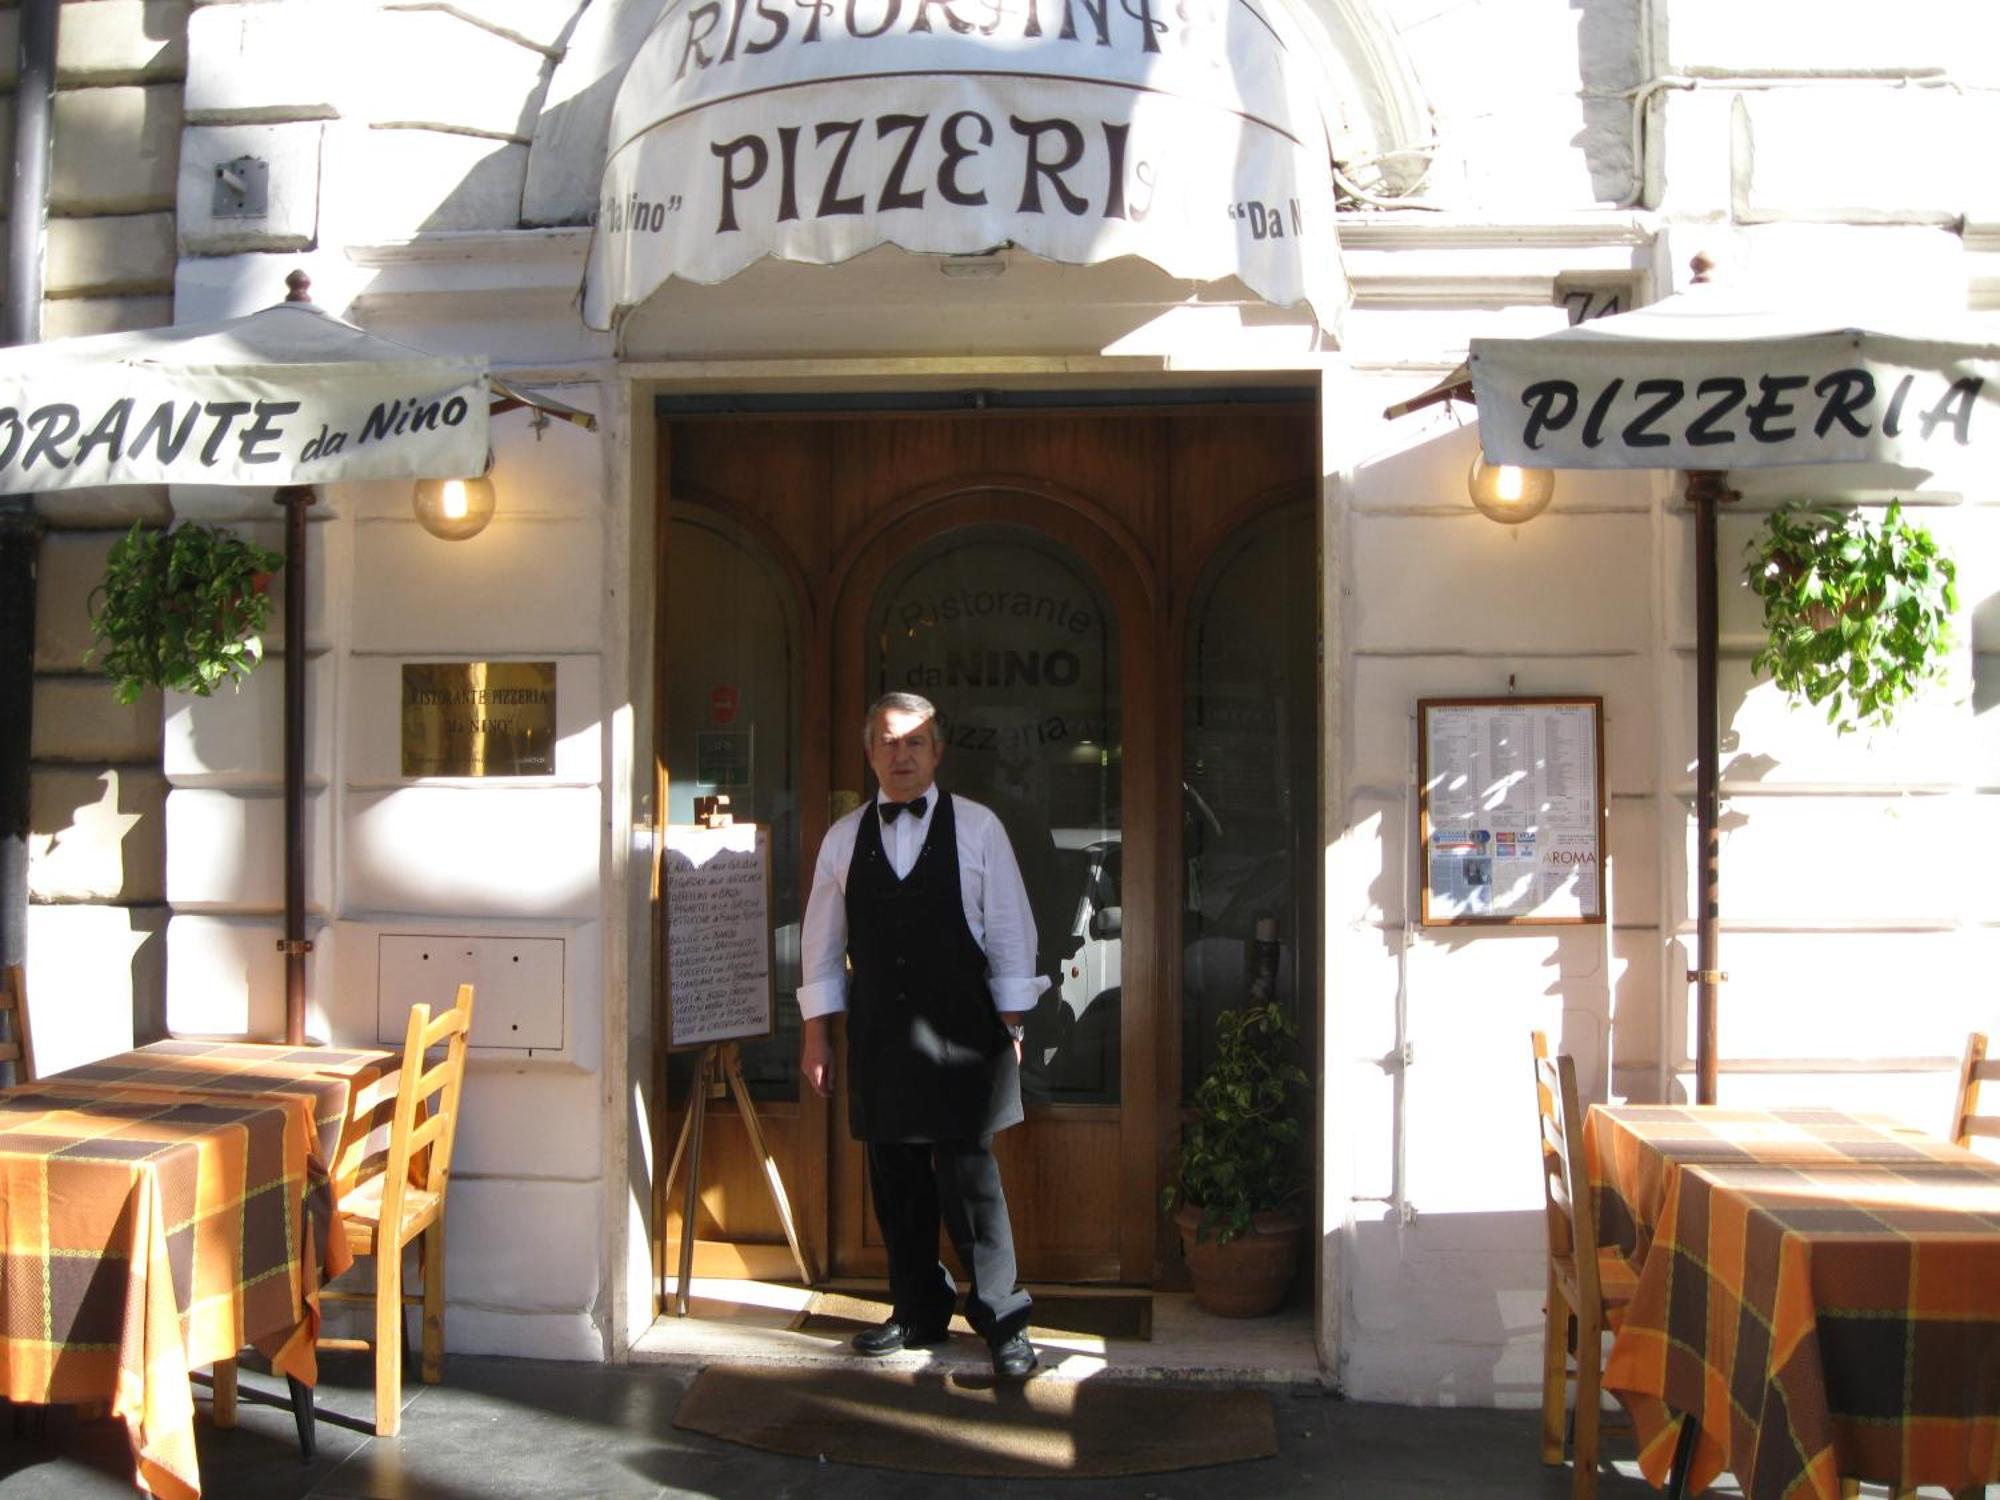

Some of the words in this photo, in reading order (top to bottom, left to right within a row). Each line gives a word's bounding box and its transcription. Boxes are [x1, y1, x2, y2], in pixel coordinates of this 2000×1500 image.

[301, 424, 348, 462] da
[357, 395, 469, 446] Nino
[1521, 368, 1985, 450] PIZZERIA
[946, 649, 1081, 688] NINO
[492, 688, 547, 705] PIZZERIA
